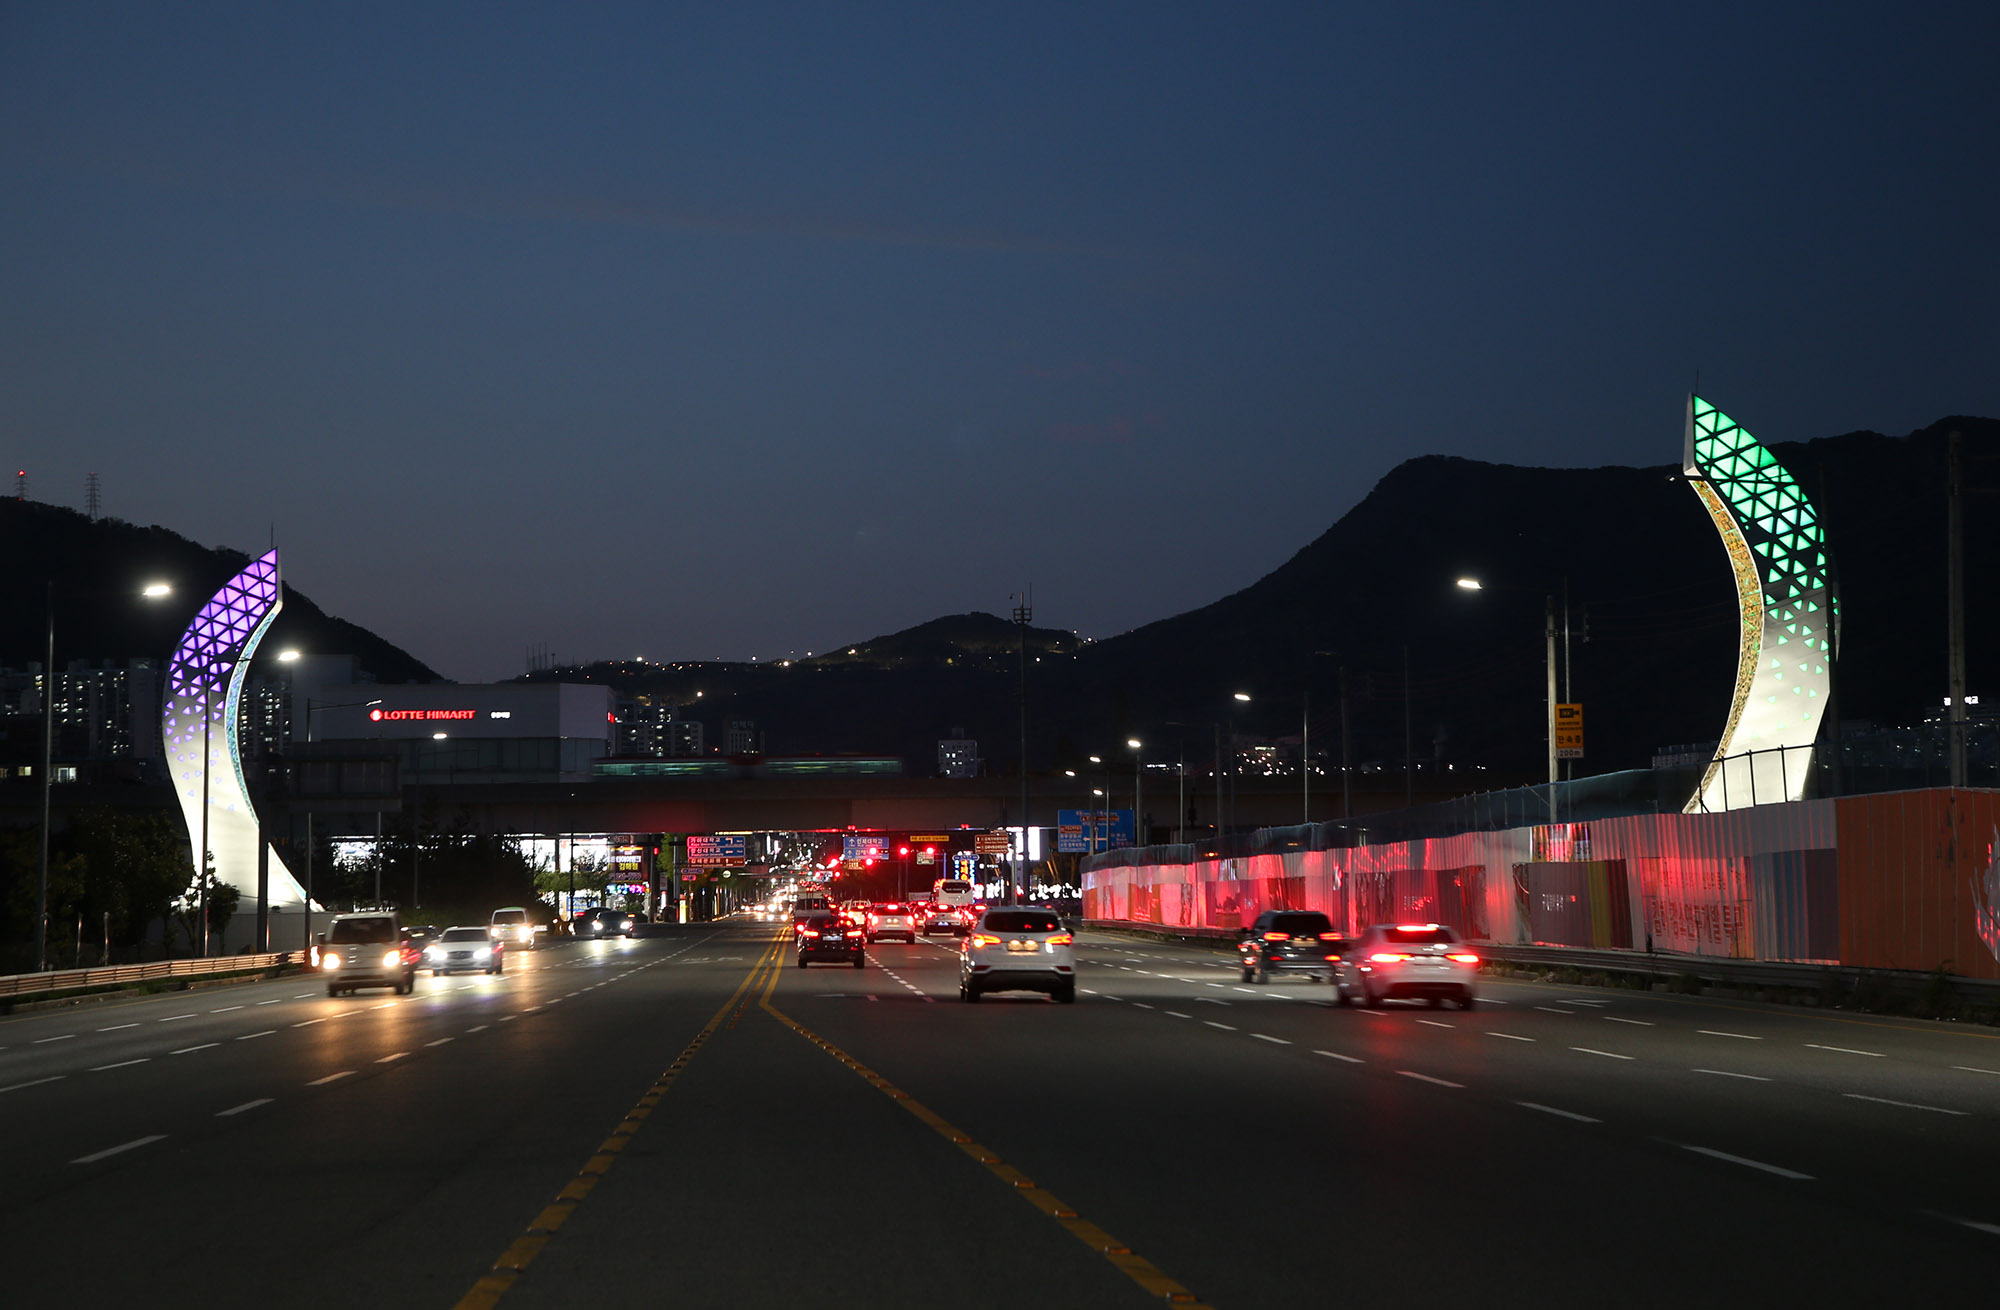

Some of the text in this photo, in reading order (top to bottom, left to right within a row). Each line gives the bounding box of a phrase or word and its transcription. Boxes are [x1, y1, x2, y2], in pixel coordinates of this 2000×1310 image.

[383, 710, 476, 720] LOTTE HIMART
[1559, 749, 1580, 757] 200m
